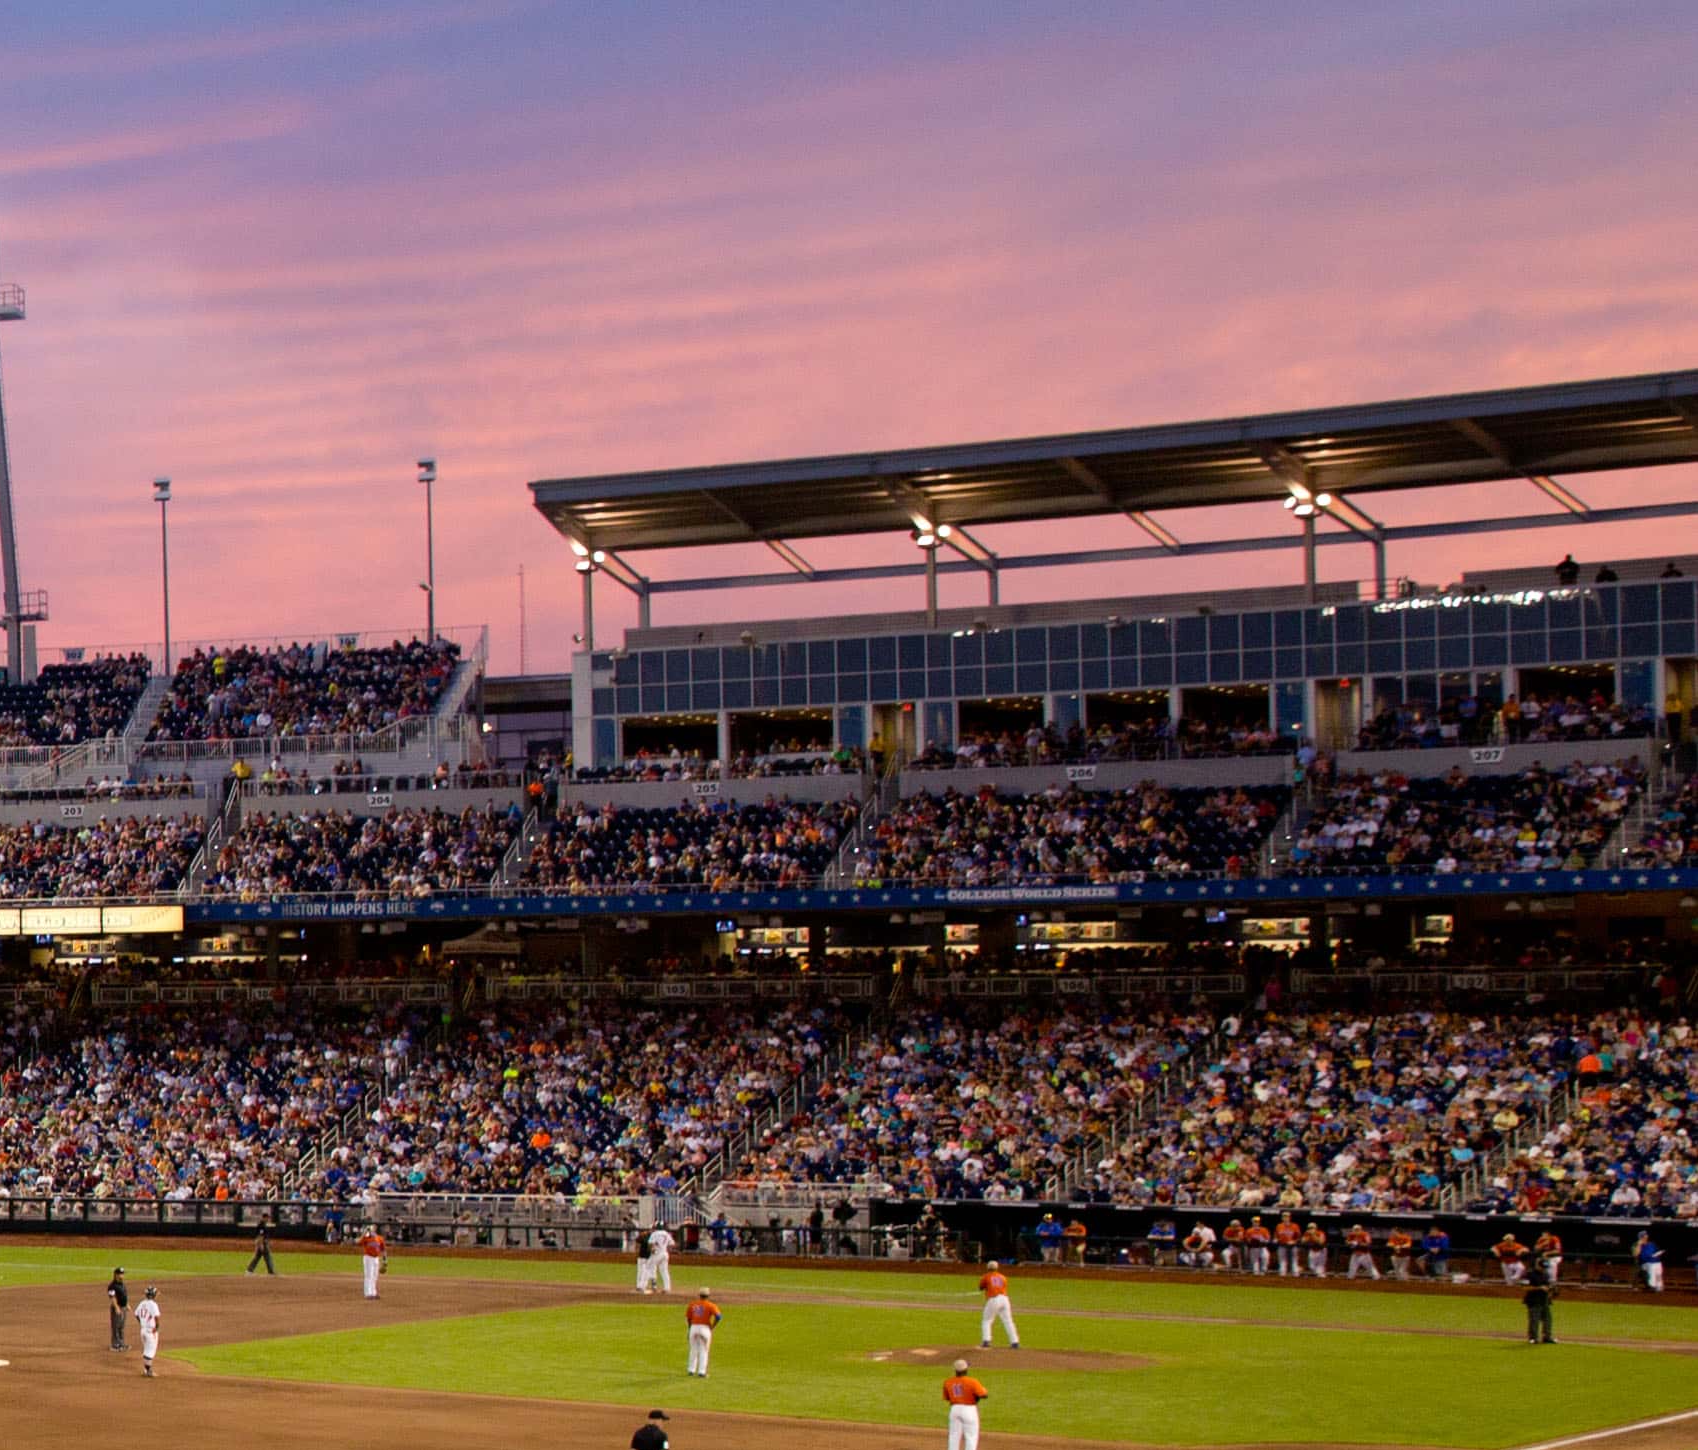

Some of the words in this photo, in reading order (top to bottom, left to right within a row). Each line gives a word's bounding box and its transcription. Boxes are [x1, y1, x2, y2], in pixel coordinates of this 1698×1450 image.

[1474, 750, 1501, 761] 207
[1070, 769, 1093, 778] 206
[697, 783, 717, 793] 205
[371, 795, 390, 805] 204
[64, 807, 82, 815] 203
[947, 888, 1010, 900] COLLEGE
[1012, 887, 1062, 899] WORLD
[1063, 887, 1117, 898] SERIES
[282, 903, 328, 916] HISTORY
[331, 902, 383, 916] HAPPENS
[387, 901, 416, 914] HERE
